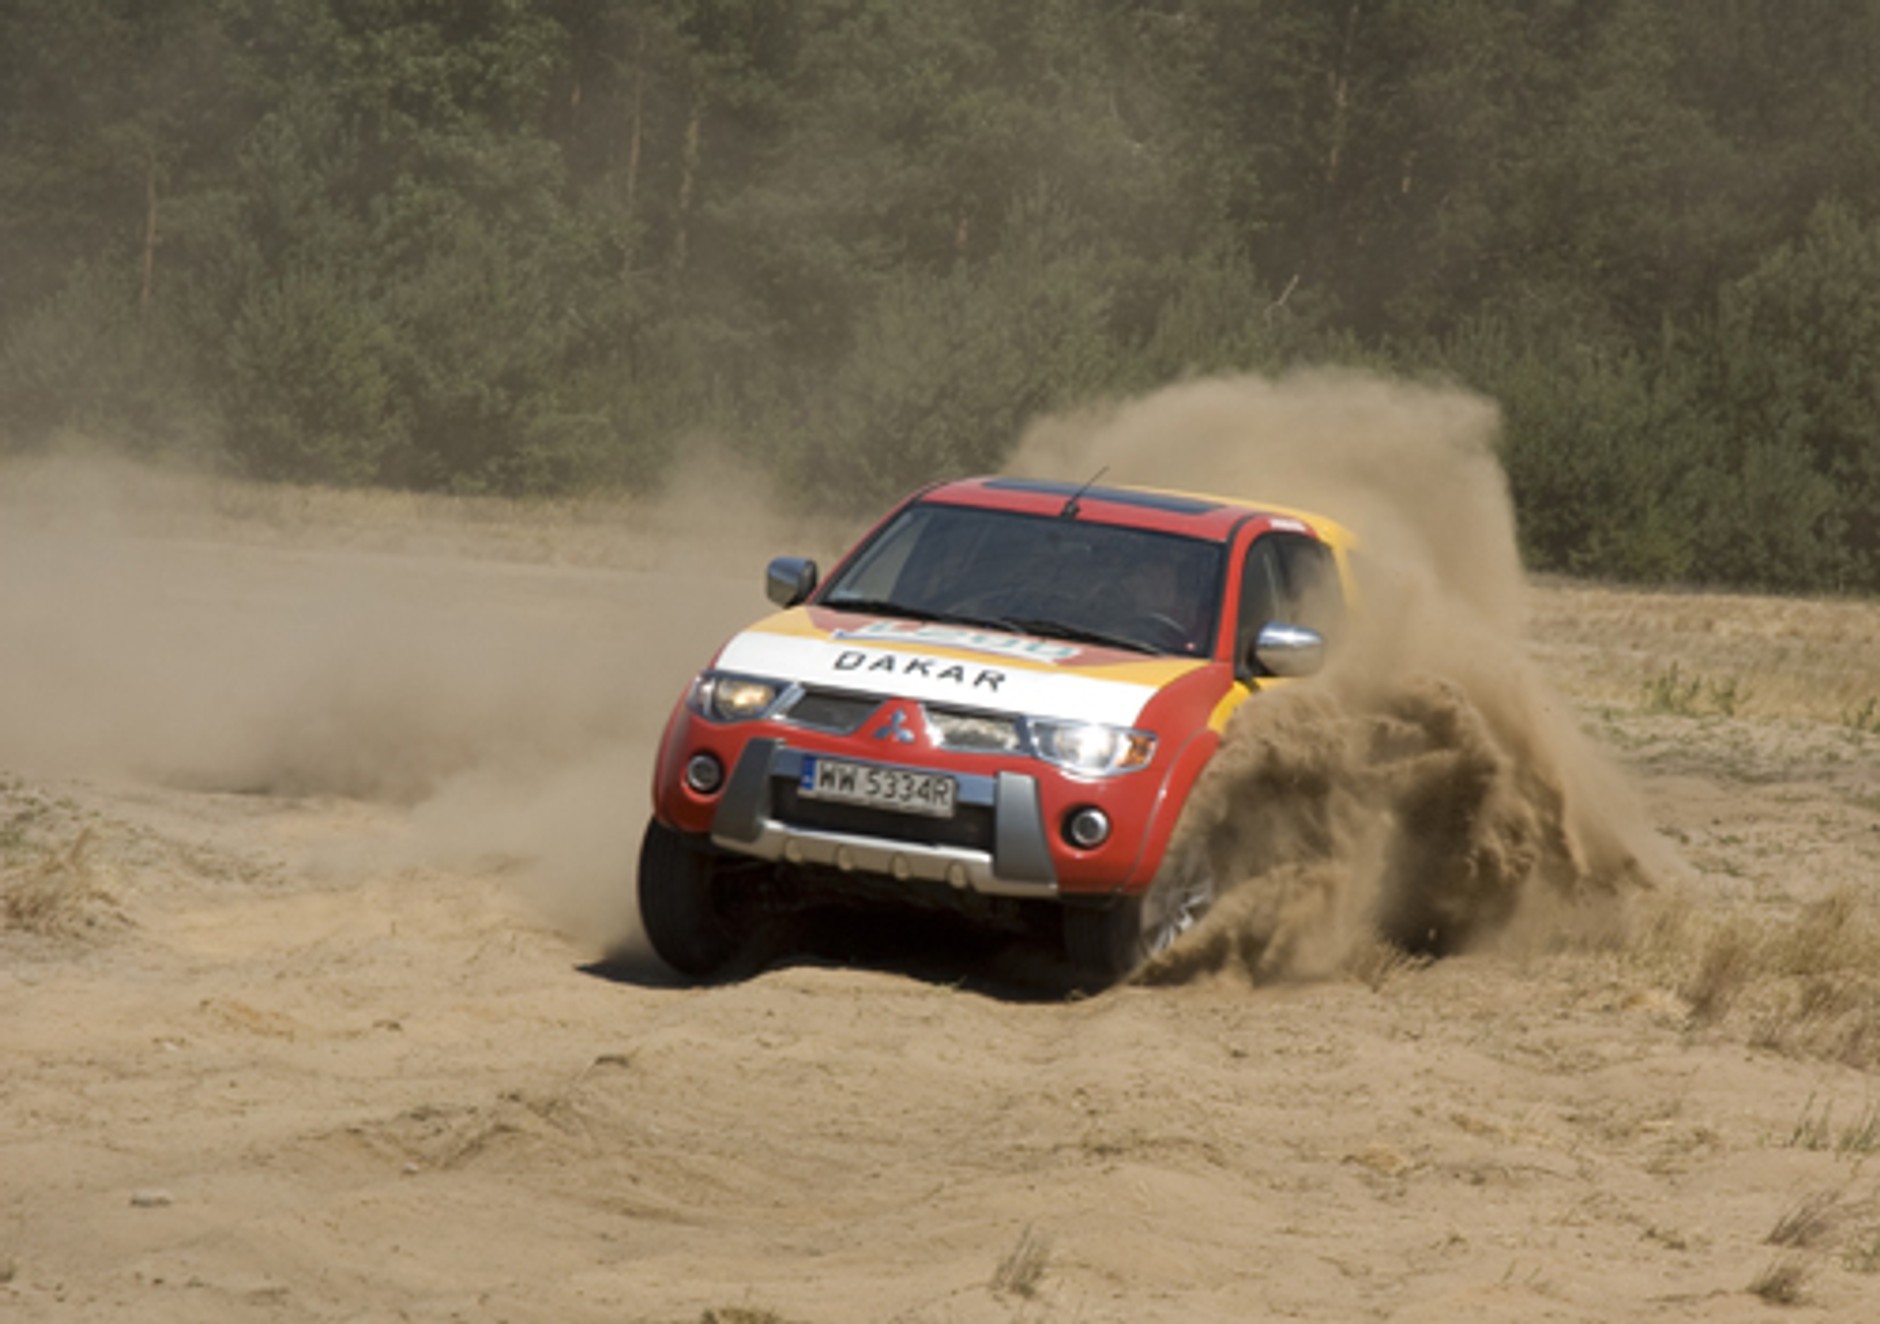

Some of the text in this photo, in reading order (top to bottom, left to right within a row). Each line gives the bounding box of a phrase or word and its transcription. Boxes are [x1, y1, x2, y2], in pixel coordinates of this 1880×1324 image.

[834, 651, 1006, 691] DAKAR
[818, 760, 949, 806] WW 5334R
